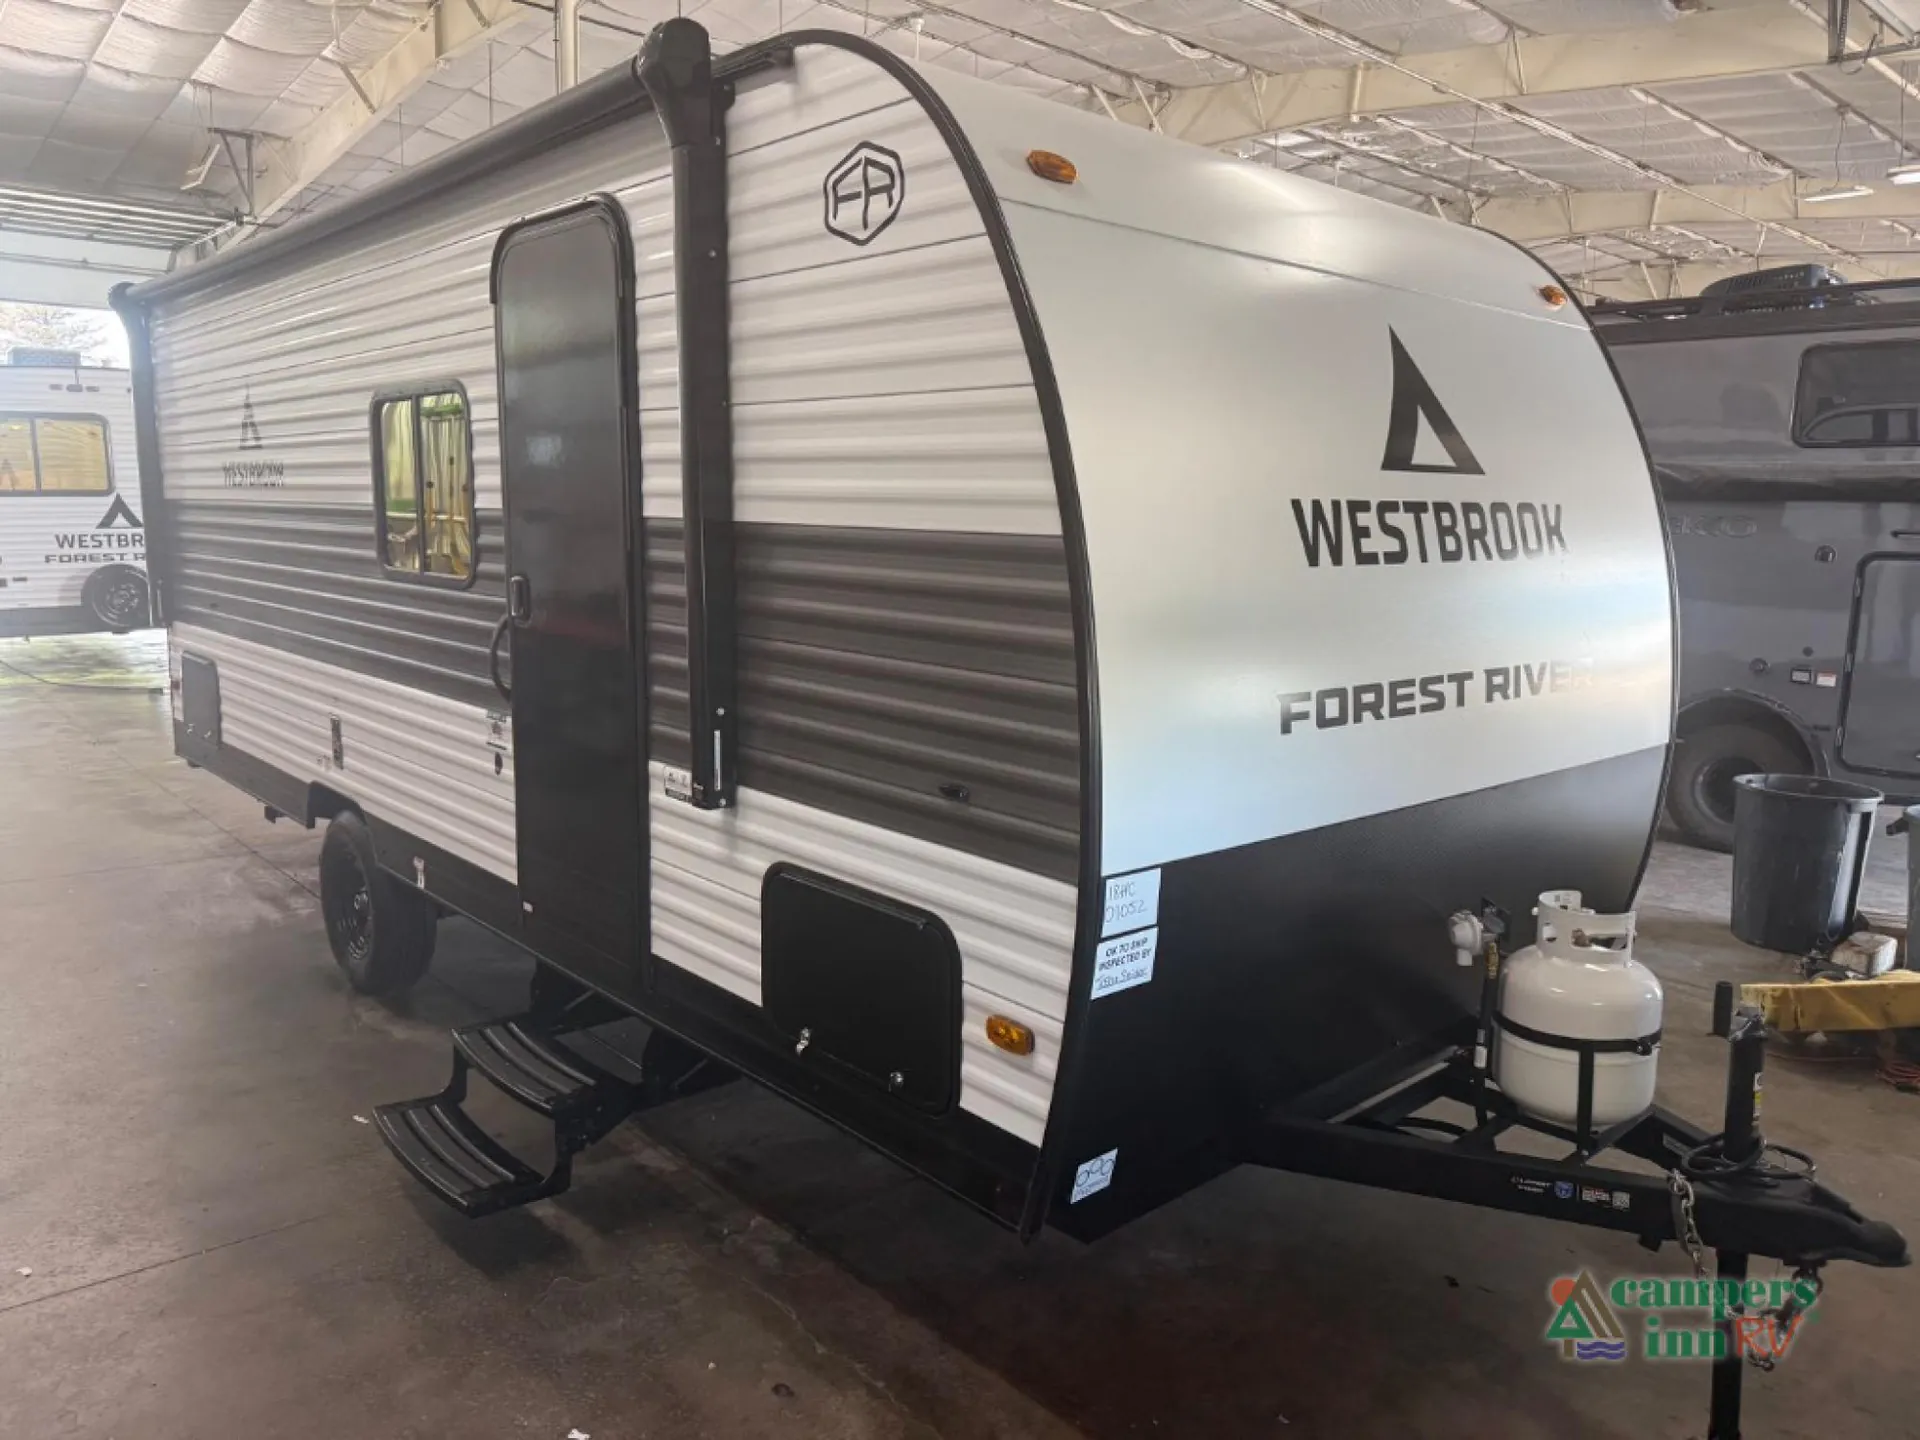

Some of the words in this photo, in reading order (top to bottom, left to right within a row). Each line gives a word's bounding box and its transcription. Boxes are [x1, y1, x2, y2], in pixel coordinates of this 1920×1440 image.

[44, 553, 128, 563] FOREST
[1290, 498, 1567, 567] WESTBROOK
[1277, 671, 1474, 735] FOREST
